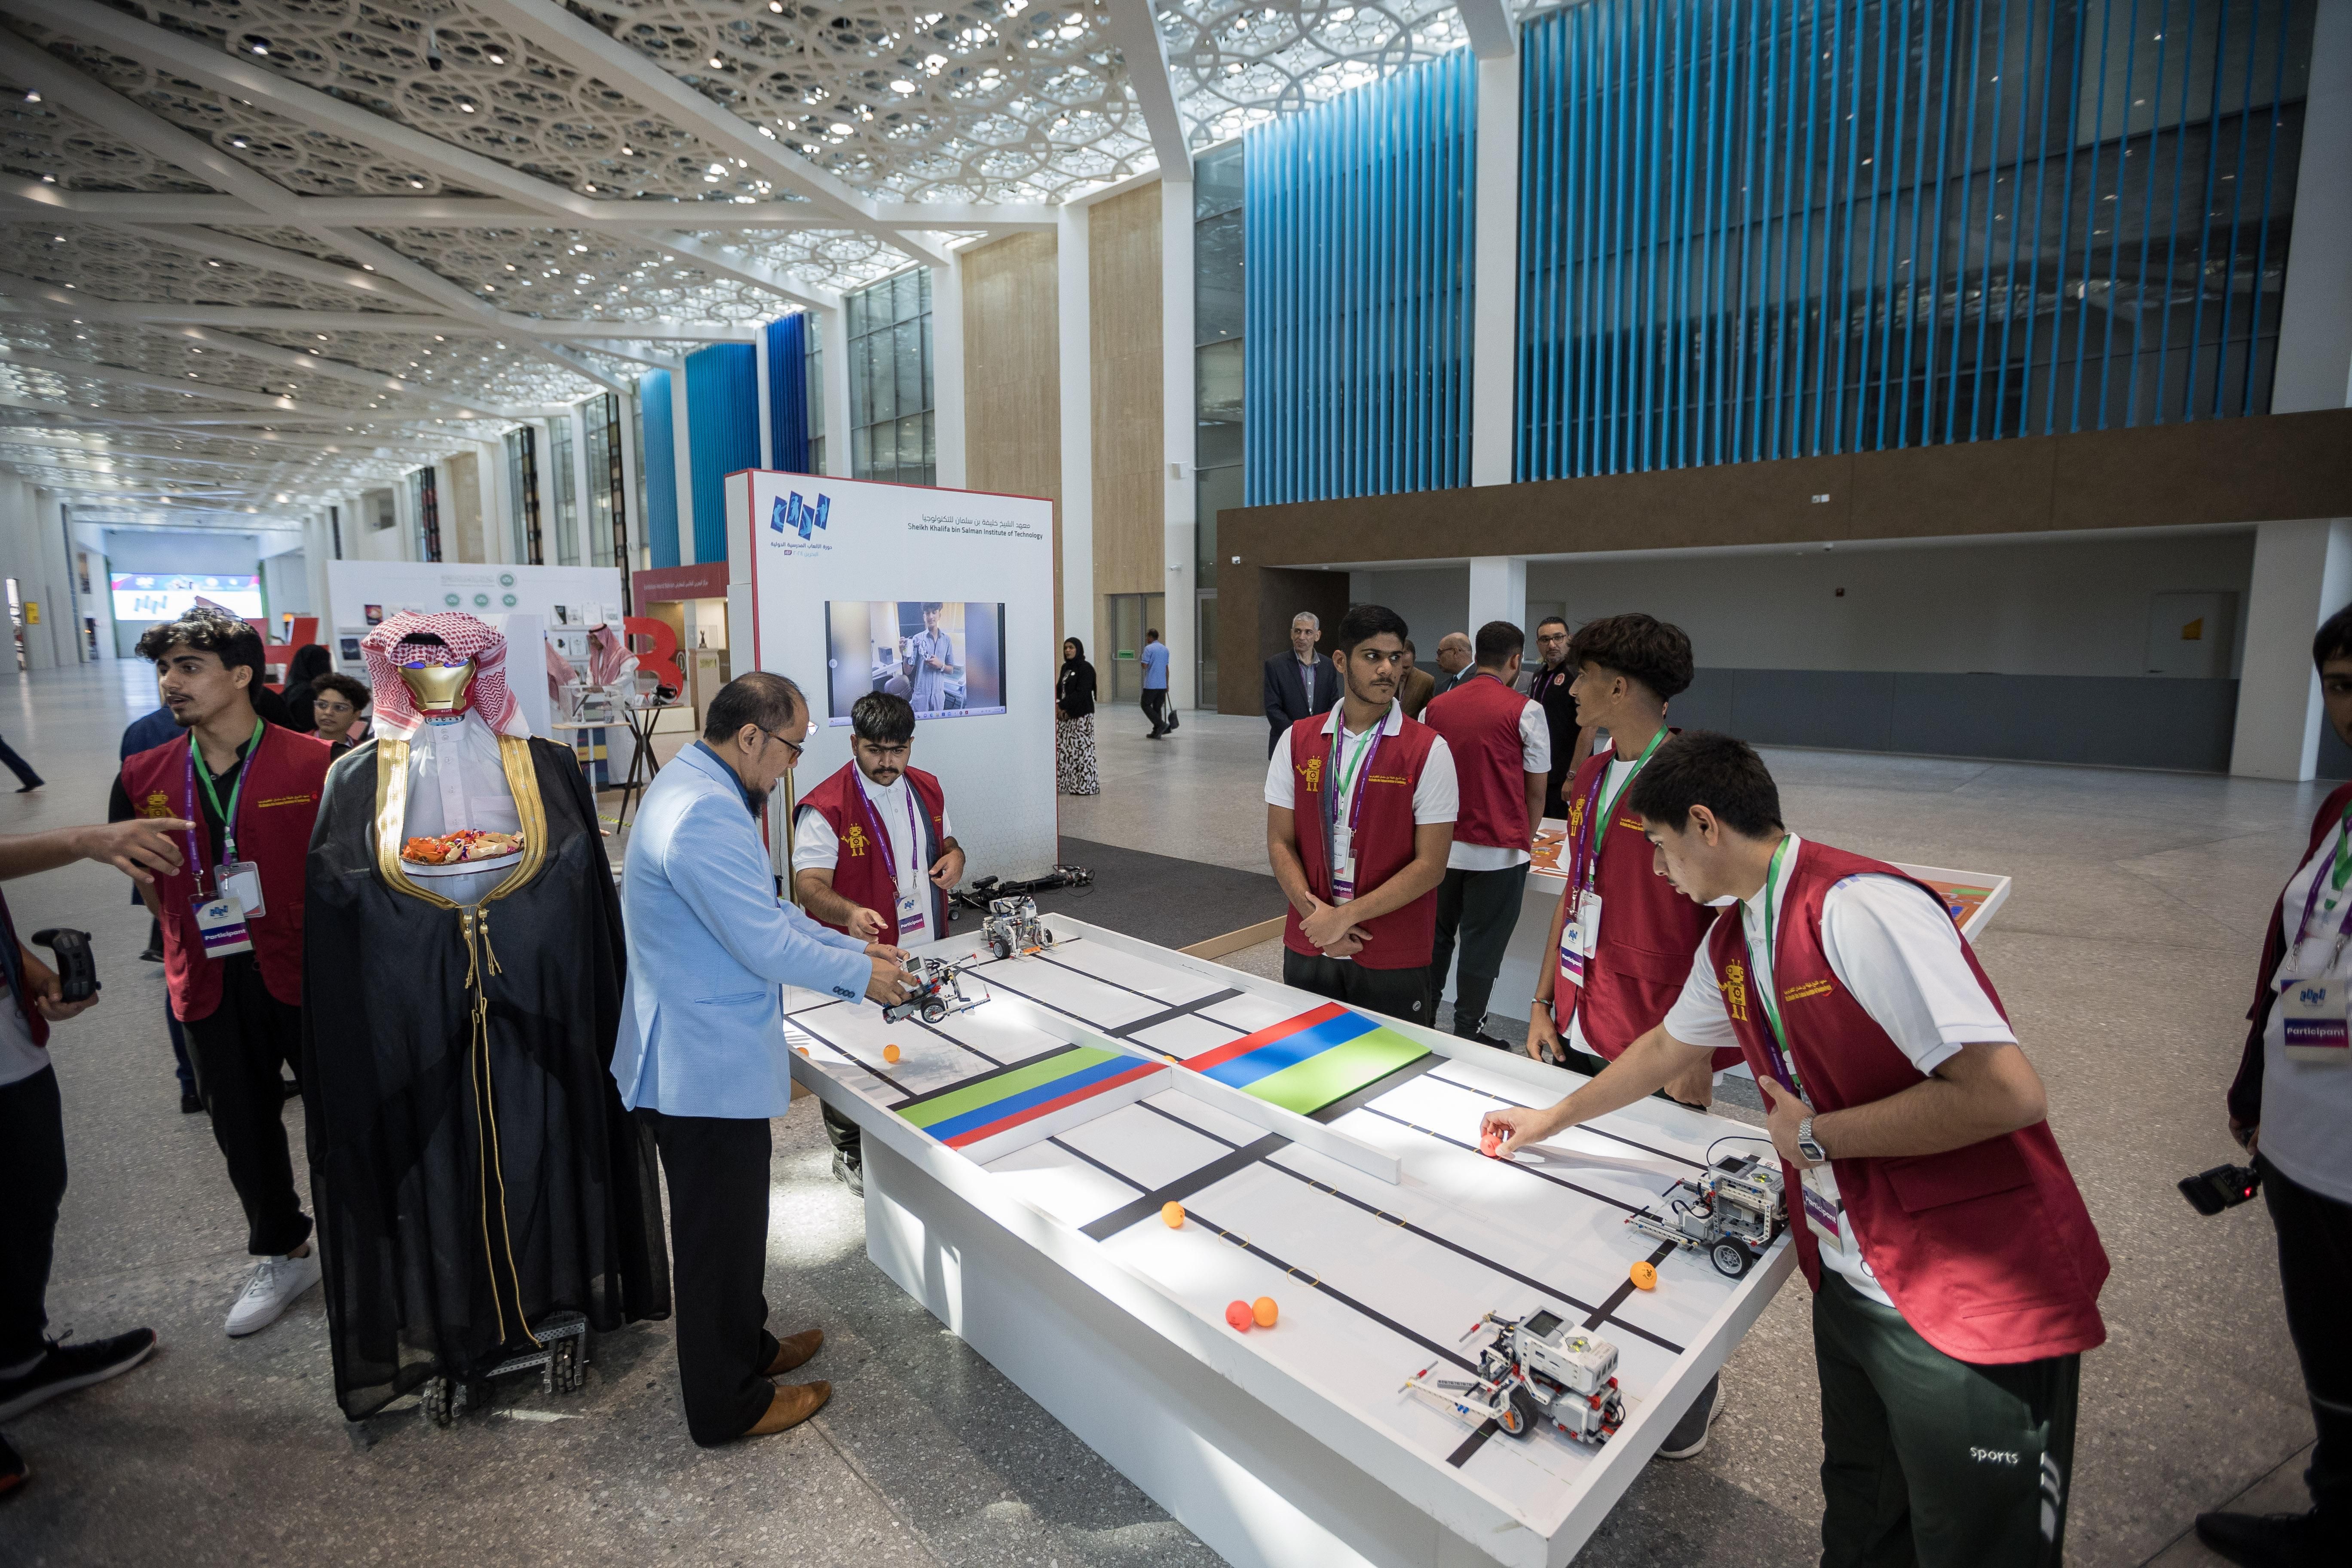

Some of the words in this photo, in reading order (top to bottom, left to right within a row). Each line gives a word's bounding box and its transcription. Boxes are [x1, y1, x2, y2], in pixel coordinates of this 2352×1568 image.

[922, 514, 953, 523] للتكنولوجيا
[955, 517, 973, 525] سلمان
[974, 518, 981, 527] بن
[999, 521, 1014, 529] الشيخ
[1014, 531, 1043, 540] Technology
[900, 918, 923, 928] Participant
[204, 928, 247, 940] Participant
[1562, 953, 1582, 968] Participant
[2287, 1027, 2345, 1038] Participant
[1805, 1195, 1836, 1223] Participant
[1970, 1447, 2019, 1464] sports
